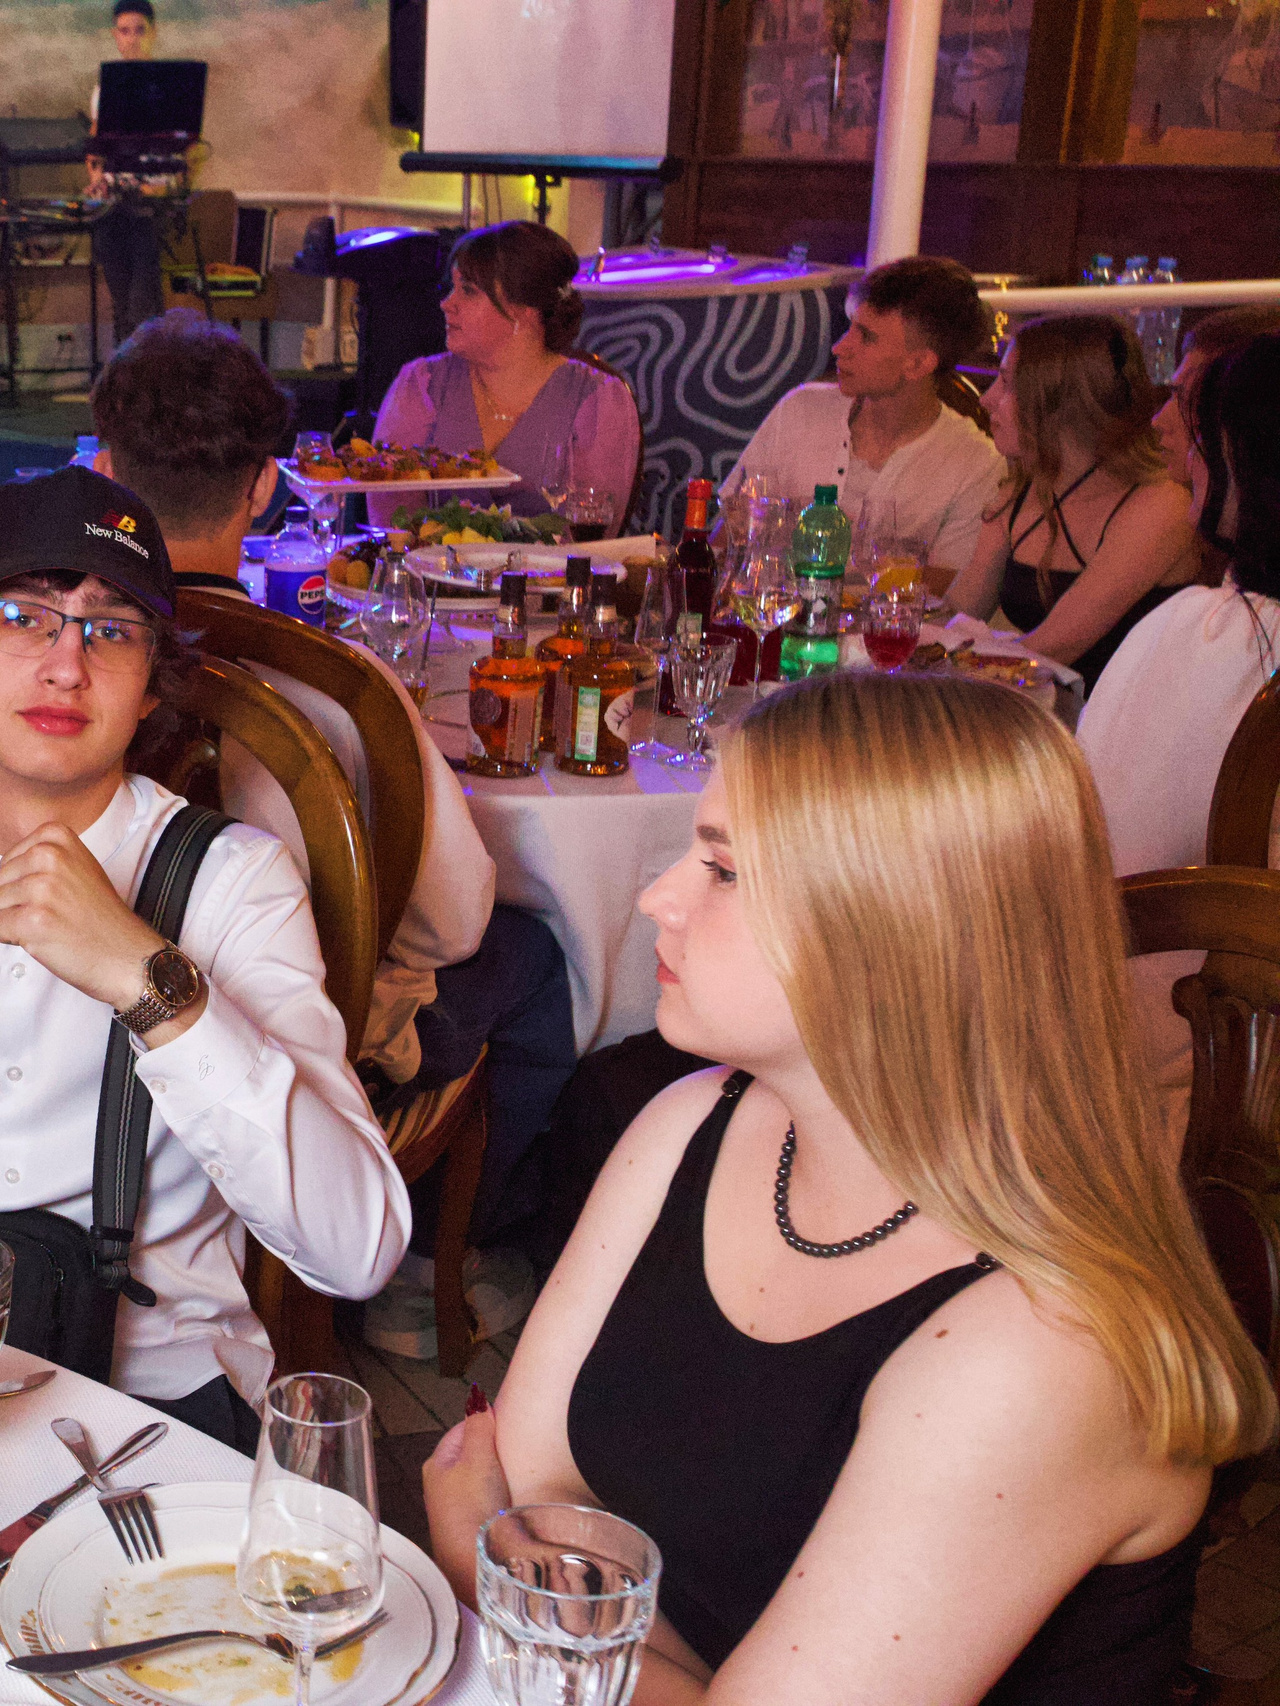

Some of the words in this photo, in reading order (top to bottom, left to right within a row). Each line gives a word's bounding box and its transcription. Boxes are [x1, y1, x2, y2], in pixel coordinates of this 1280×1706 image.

[84, 522, 114, 539] New
[113, 529, 150, 559] Balance
[299, 589, 326, 600] PEPS
